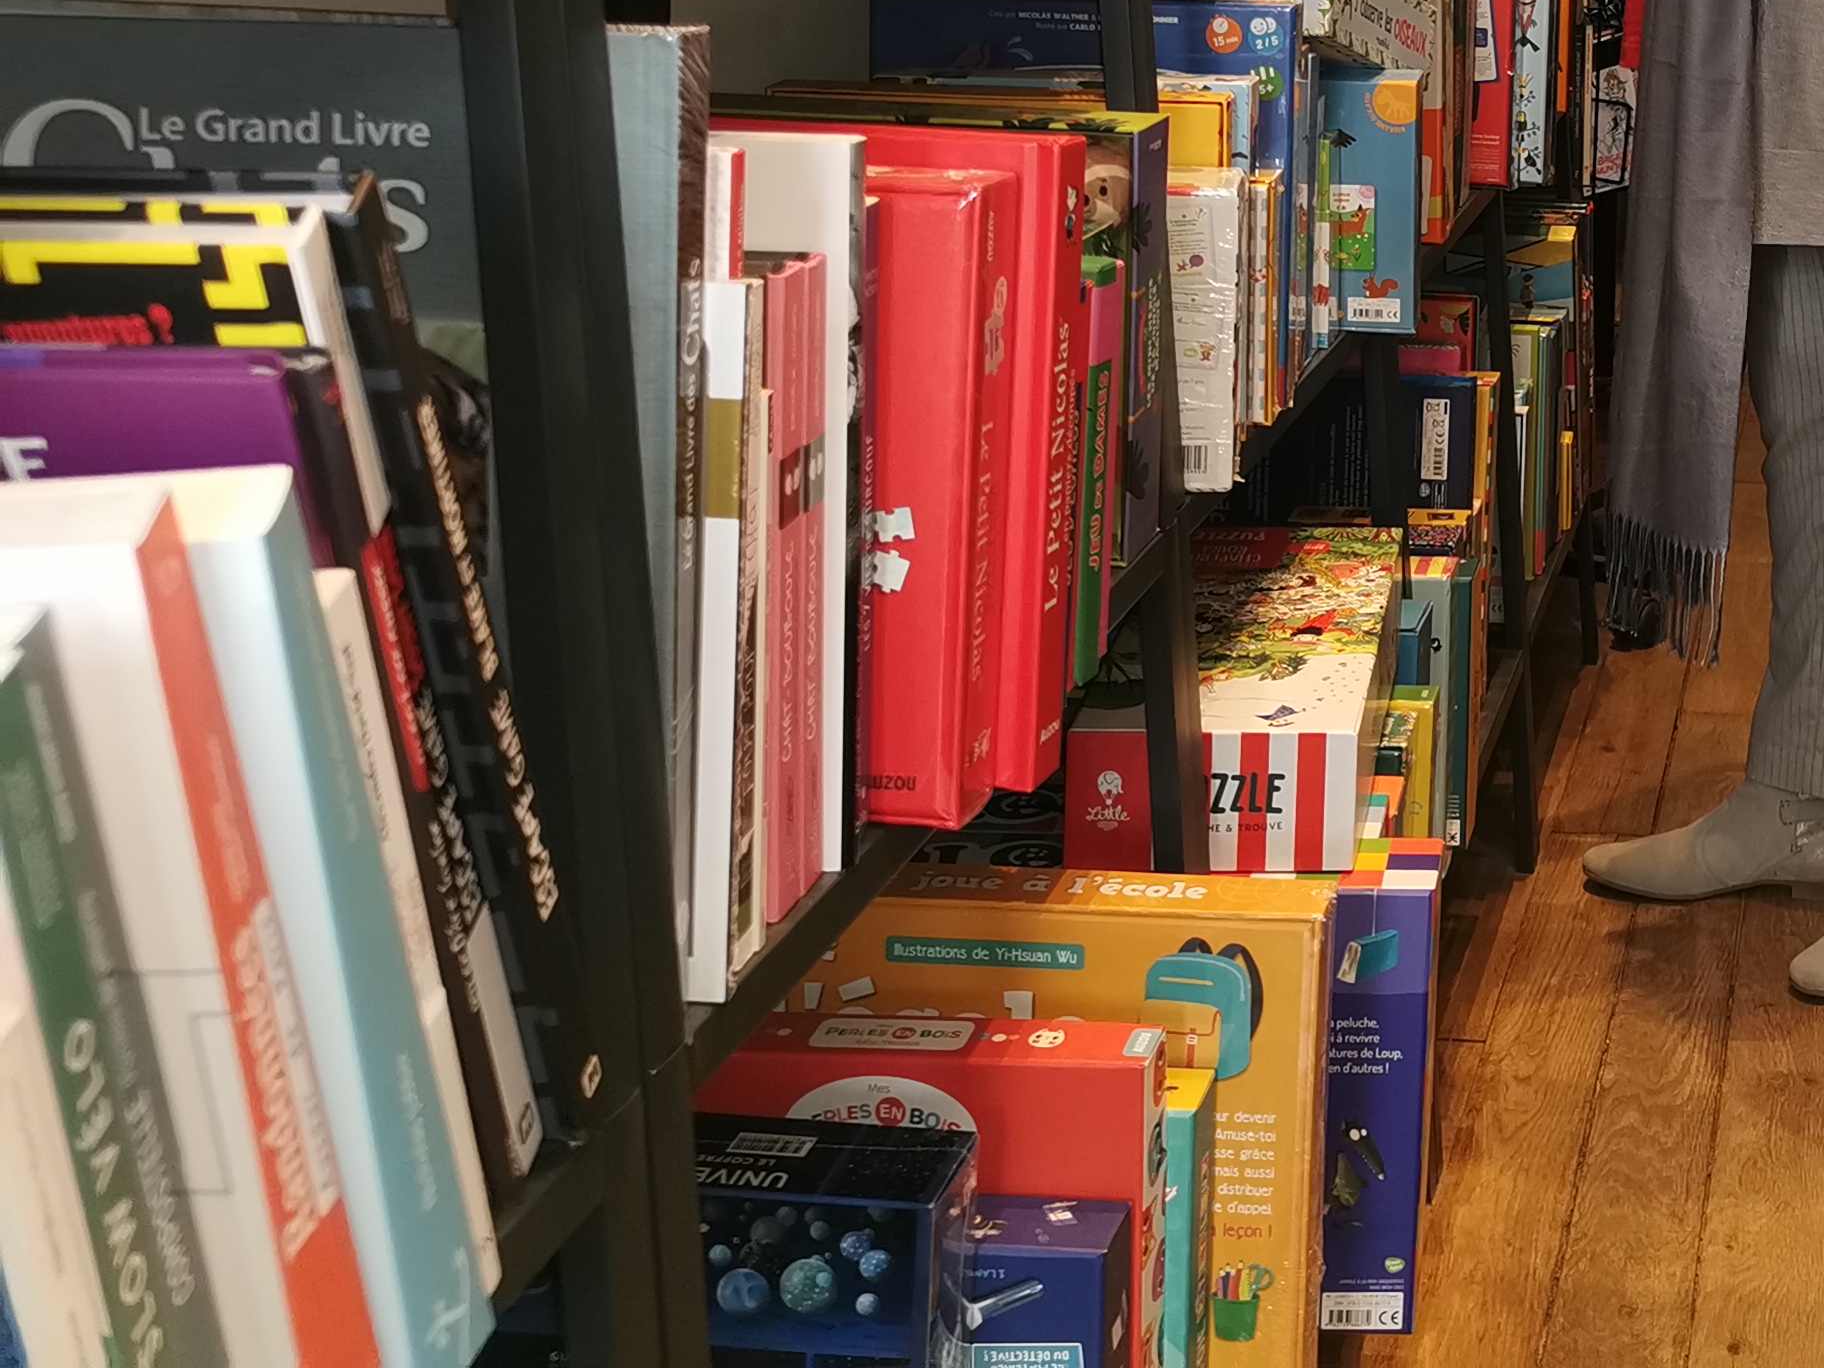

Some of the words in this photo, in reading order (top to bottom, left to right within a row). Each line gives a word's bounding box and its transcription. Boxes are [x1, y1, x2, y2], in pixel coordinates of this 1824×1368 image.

[1213, 36, 1226, 47] 15
[1393, 18, 1428, 57] OISEAUX
[139, 106, 186, 142] Le
[195, 108, 321, 145] Grand
[332, 111, 431, 147] Livre
[680, 255, 704, 366] Chats
[682, 373, 698, 412] des
[1050, 322, 1072, 456] Nicolas
[1092, 369, 1111, 477] DAMES
[681, 418, 697, 466] Livre
[680, 473, 696, 545] Grand
[1045, 466, 1066, 557] Petit
[1087, 515, 1102, 573] JEU
[1043, 577, 1061, 614] Le
[1085, 805, 1130, 822] Little
[1238, 821, 1284, 833] TROUVE
[915, 870, 1004, 890] joue
[1023, 871, 1051, 891] à
[1068, 876, 1209, 899] l'école
[893, 942, 967, 959] Illustrations
[972, 946, 990, 960] de
[995, 947, 1053, 964] Yi-Hsuan
[1056, 949, 1078, 965] Wu
[825, 1026, 888, 1039] PERLES
[896, 1027, 912, 1039] EN
[919, 1028, 964, 1039] BOIS
[1336, 1017, 1380, 1031] peluche,
[1344, 1033, 1380, 1043] revivre
[1360, 1048, 1374, 1059] de
[1375, 1048, 1404, 1060] Loup,
[1341, 1062, 1384, 1074] d'autres
[868, 1083, 891, 1094] Mes
[879, 1103, 904, 1121] EN
[1233, 1111, 1277, 1124] devenir
[1214, 1129, 1277, 1143] Amuse-toi
[1240, 1147, 1275, 1161] grâce
[1244, 1166, 1275, 1179] aussi
[1217, 1183, 1274, 1197] distribuer
[1222, 1222, 1263, 1240] leçon
[1053, 1350, 1070, 1362] DU
